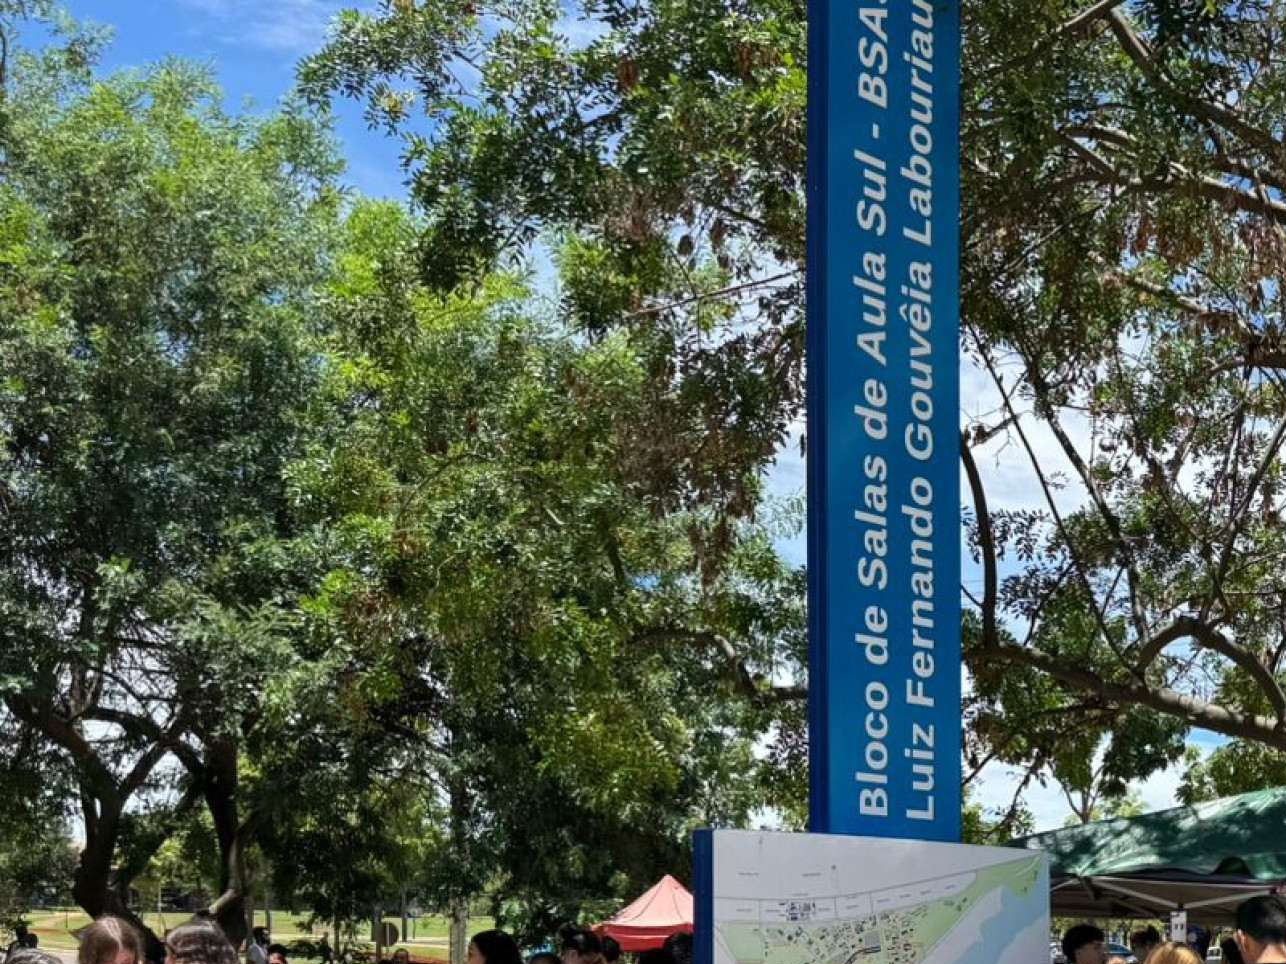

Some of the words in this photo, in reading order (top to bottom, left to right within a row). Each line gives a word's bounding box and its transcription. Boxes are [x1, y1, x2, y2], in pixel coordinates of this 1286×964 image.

[858, 0, 888, 108] BSA
[900, 0, 933, 246] Labouriau
[854, 150, 887, 236] Sul
[853, 252, 887, 366] Aula
[899, 261, 933, 461] Gouvêia
[854, 378, 888, 440] de
[854, 455, 888, 590] Salas
[855, 605, 889, 665] de
[901, 477, 935, 707] Fernando
[855, 681, 889, 816] Bloco
[904, 723, 935, 820] Luiz
